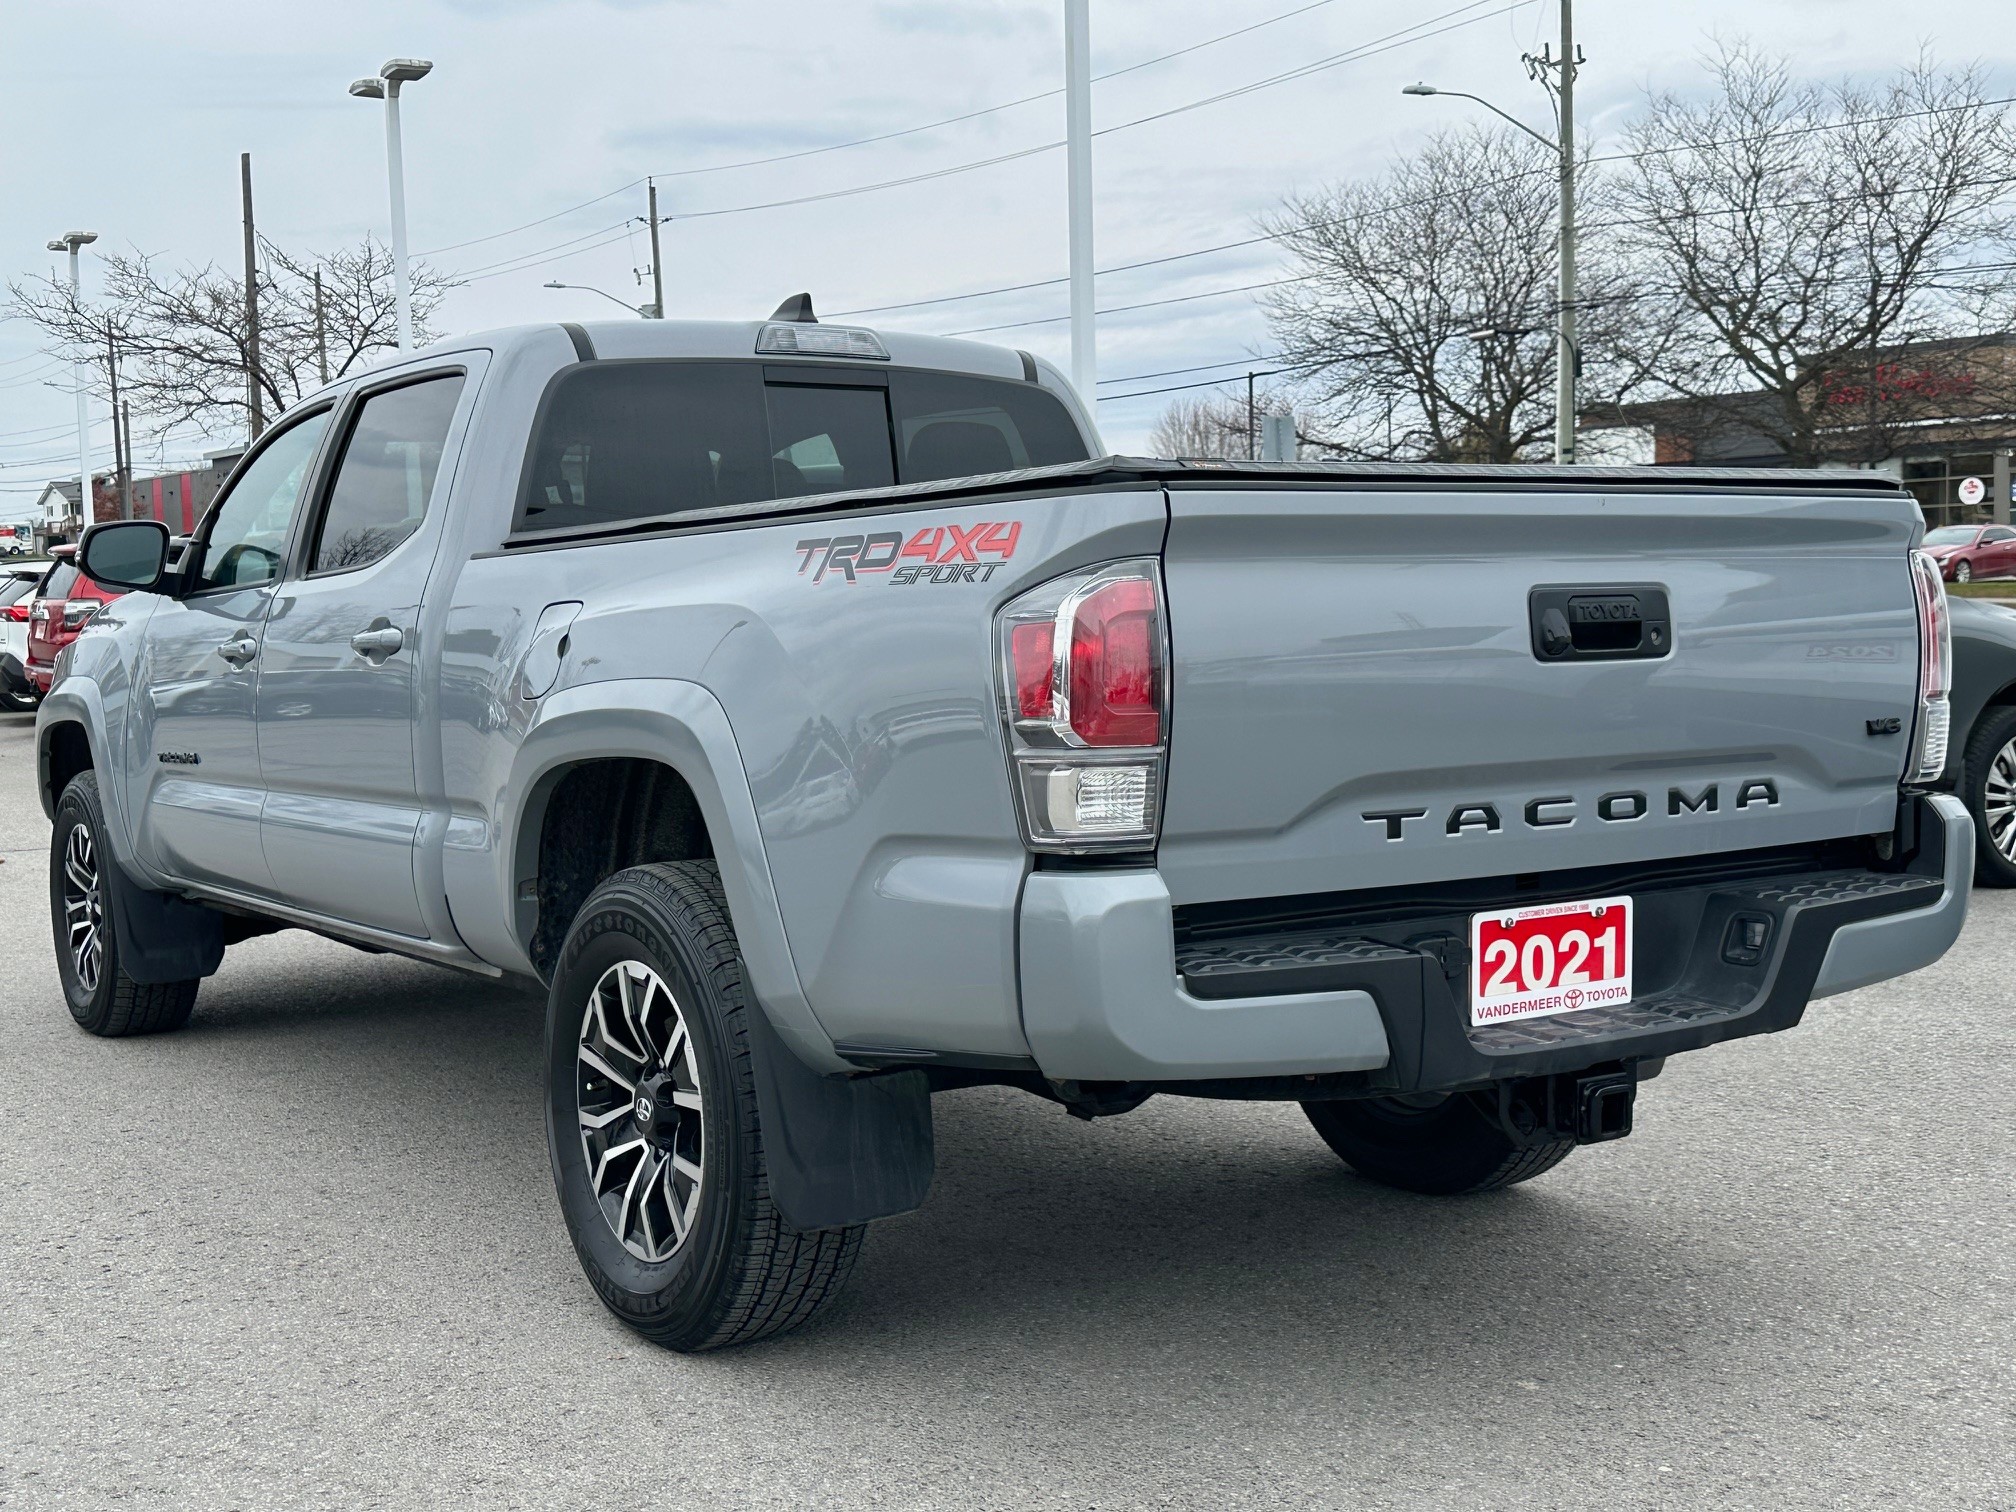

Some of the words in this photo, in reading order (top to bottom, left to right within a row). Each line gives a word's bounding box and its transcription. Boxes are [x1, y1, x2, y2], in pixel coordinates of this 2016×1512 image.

[796, 531, 903, 584] TRD
[901, 521, 1022, 564] 4X4
[889, 562, 1007, 585] SPORT
[1579, 601, 1640, 620] TOYOTA
[1866, 718, 1901, 736] V6
[1360, 777, 1781, 842] TACOMA
[1518, 909, 1545, 919] CUSTOMER
[1546, 906, 1563, 915] DRIVEN
[1484, 926, 1616, 997] 2021
[1477, 996, 1562, 1019] VANDERMEER
[1586, 986, 1628, 1003] TOYOTA
